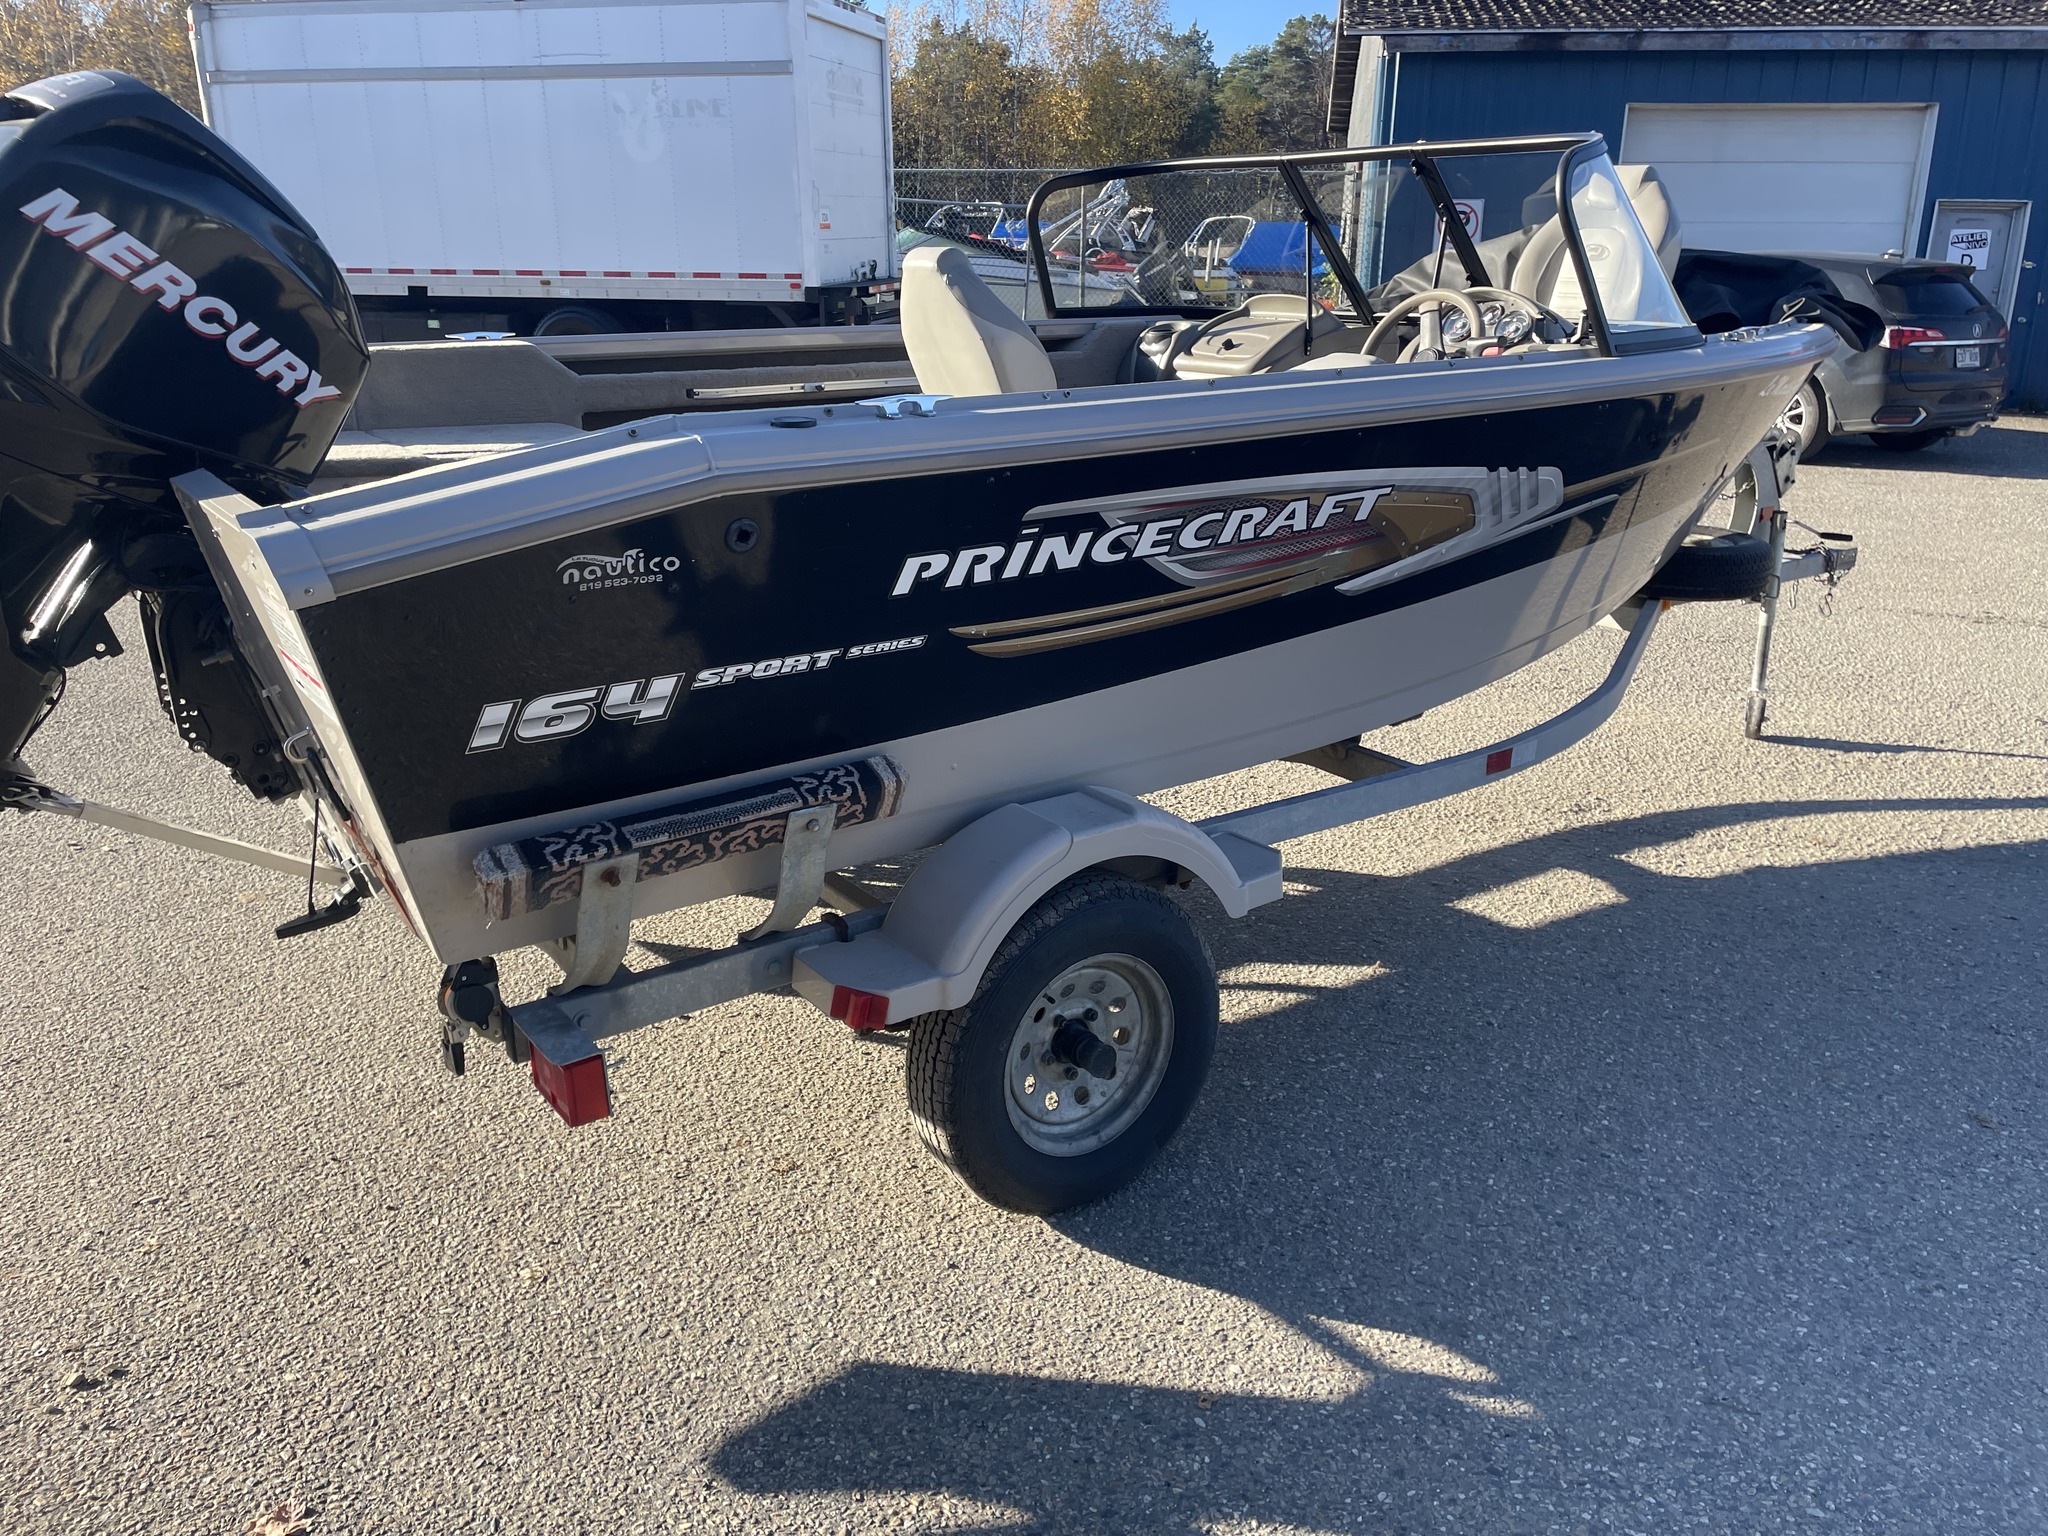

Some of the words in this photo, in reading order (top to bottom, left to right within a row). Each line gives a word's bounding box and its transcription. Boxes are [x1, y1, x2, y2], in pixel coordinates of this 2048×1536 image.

[1951, 232, 1987, 243] ATELIER
[1965, 240, 1988, 249] NIVO
[19, 187, 342, 409] MERCURY
[891, 484, 1395, 598] PRINCECRAFT
[562, 550, 681, 585] nautico
[579, 581, 603, 592] 819
[604, 574, 664, 588] 523-7092
[465, 673, 686, 755] 164
[690, 648, 844, 690] SPORT
[846, 635, 929, 661] SERIES
